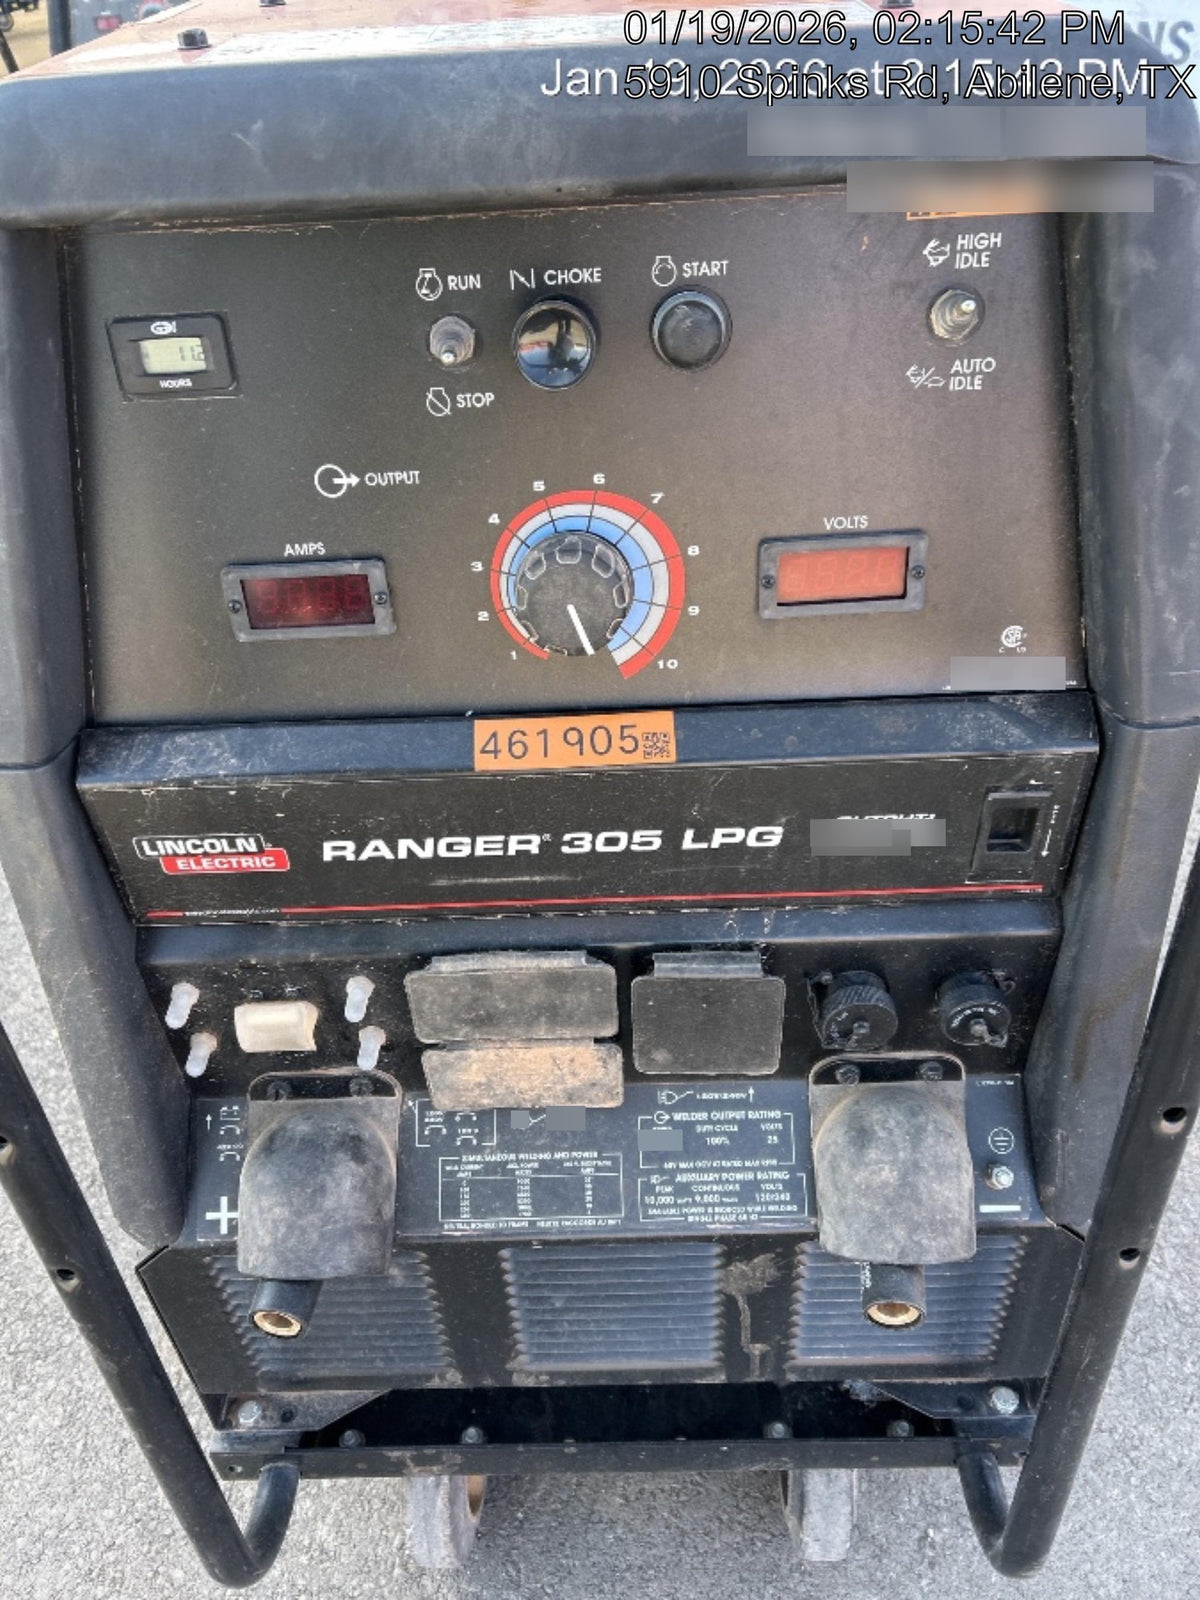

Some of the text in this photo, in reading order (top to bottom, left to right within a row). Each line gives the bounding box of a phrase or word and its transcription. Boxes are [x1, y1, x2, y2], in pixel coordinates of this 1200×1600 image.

[956, 232, 1002, 250] HIGH
[955, 251, 991, 269] IDLE
[682, 259, 729, 278] START
[446, 274, 482, 291] RUN
[544, 268, 602, 286] CHOKE
[950, 357, 996, 374] AUTO
[949, 375, 984, 391] IDLE
[456, 391, 494, 409] STOP
[364, 470, 420, 486] OUTPUT
[532, 481, 545, 491] 5
[593, 473, 605, 484] 6
[650, 492, 664, 504] 7
[488, 513, 500, 525] 4
[823, 515, 869, 531] VOLTS
[283, 542, 326, 557] AMPS
[687, 546, 700, 556] 8
[471, 562, 483, 572] 3
[477, 611, 490, 621] 2
[688, 606, 700, 616] 9
[510, 650, 517, 660] 1
[657, 658, 678, 669] 10
[479, 724, 639, 761] 461905
[141, 836, 259, 857] LINCOLN
[561, 831, 662, 853] 305
[681, 825, 785, 851] LPG
[176, 855, 276, 871] ELECTRIC
